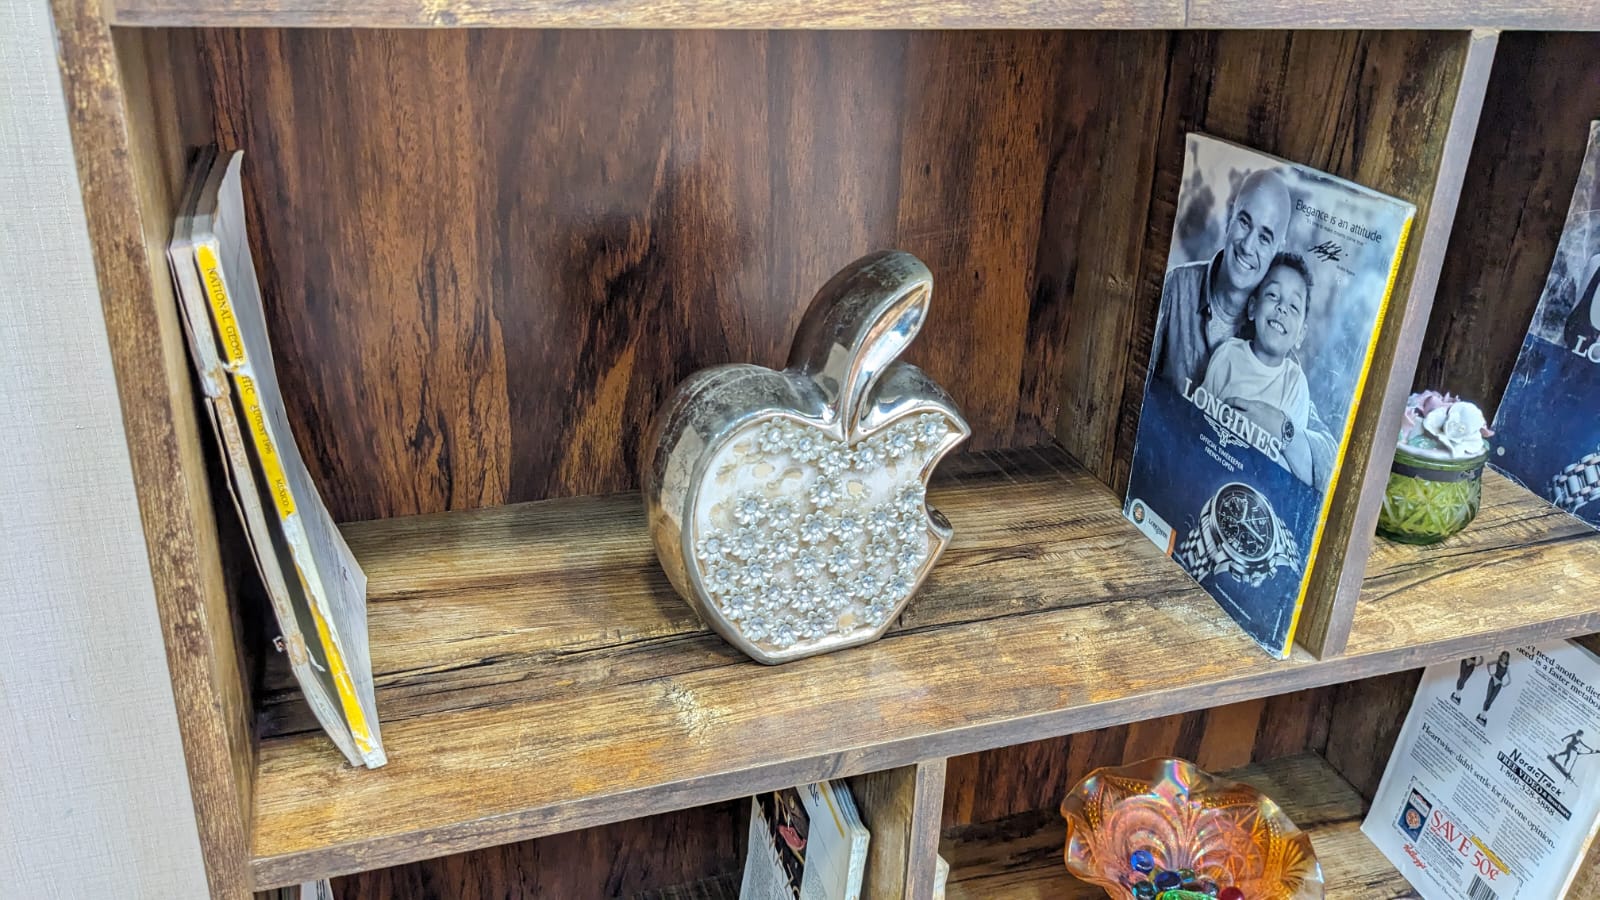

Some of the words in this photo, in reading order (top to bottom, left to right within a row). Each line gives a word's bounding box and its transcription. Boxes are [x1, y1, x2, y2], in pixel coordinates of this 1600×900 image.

[1296, 199, 1328, 222] Elegance
[1330, 216, 1337, 225] is
[1338, 220, 1348, 230] an
[1350, 224, 1382, 243] attitude
[206, 267, 231, 322] NATIONAL
[1182, 377, 1283, 462] LONGINES
[1199, 433, 1218, 451] OFFICIAL
[1218, 446, 1244, 471] TIMEKEEPER
[1204, 446, 1223, 463] FRENCH
[1221, 458, 1235, 472] OPEN
[1535, 657, 1542, 666] is
[1548, 667, 1570, 687] faster
[1536, 650, 1555, 666] need
[1555, 663, 1585, 688] another
[1455, 753, 1474, 773] didn't
[1473, 770, 1492, 790] settle
[1490, 785, 1502, 799] for
[1500, 795, 1515, 811] just
[1514, 808, 1528, 822] one
[1498, 752, 1518, 772] FREE
[1518, 769, 1543, 794] VIDEO
[1431, 809, 1473, 857] SAVE
[1470, 850, 1500, 880] 50¢
